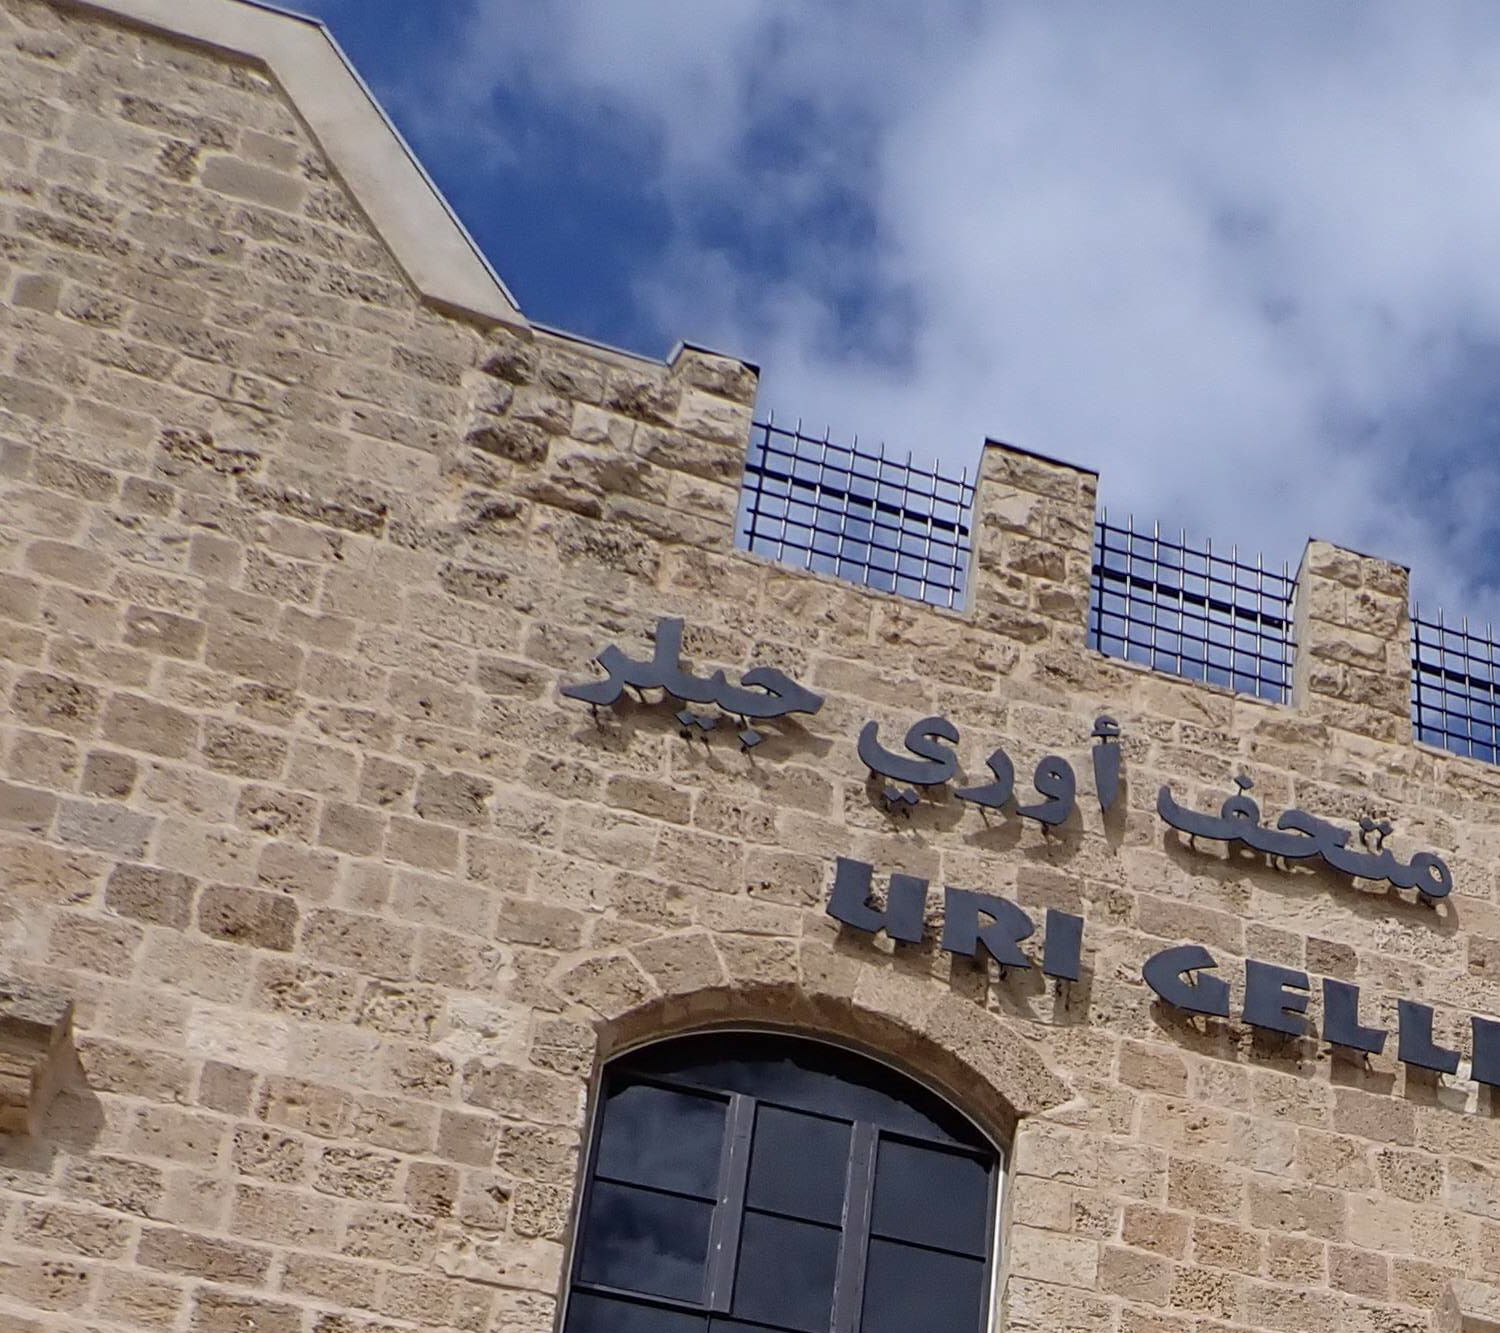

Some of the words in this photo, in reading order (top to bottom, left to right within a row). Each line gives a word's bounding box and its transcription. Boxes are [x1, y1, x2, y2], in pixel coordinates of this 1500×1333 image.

[559, 615, 825, 747] جيلر
[857, 714, 1121, 825] أوري
[1157, 774, 1452, 897] متحف
[826, 855, 1085, 982] URI
